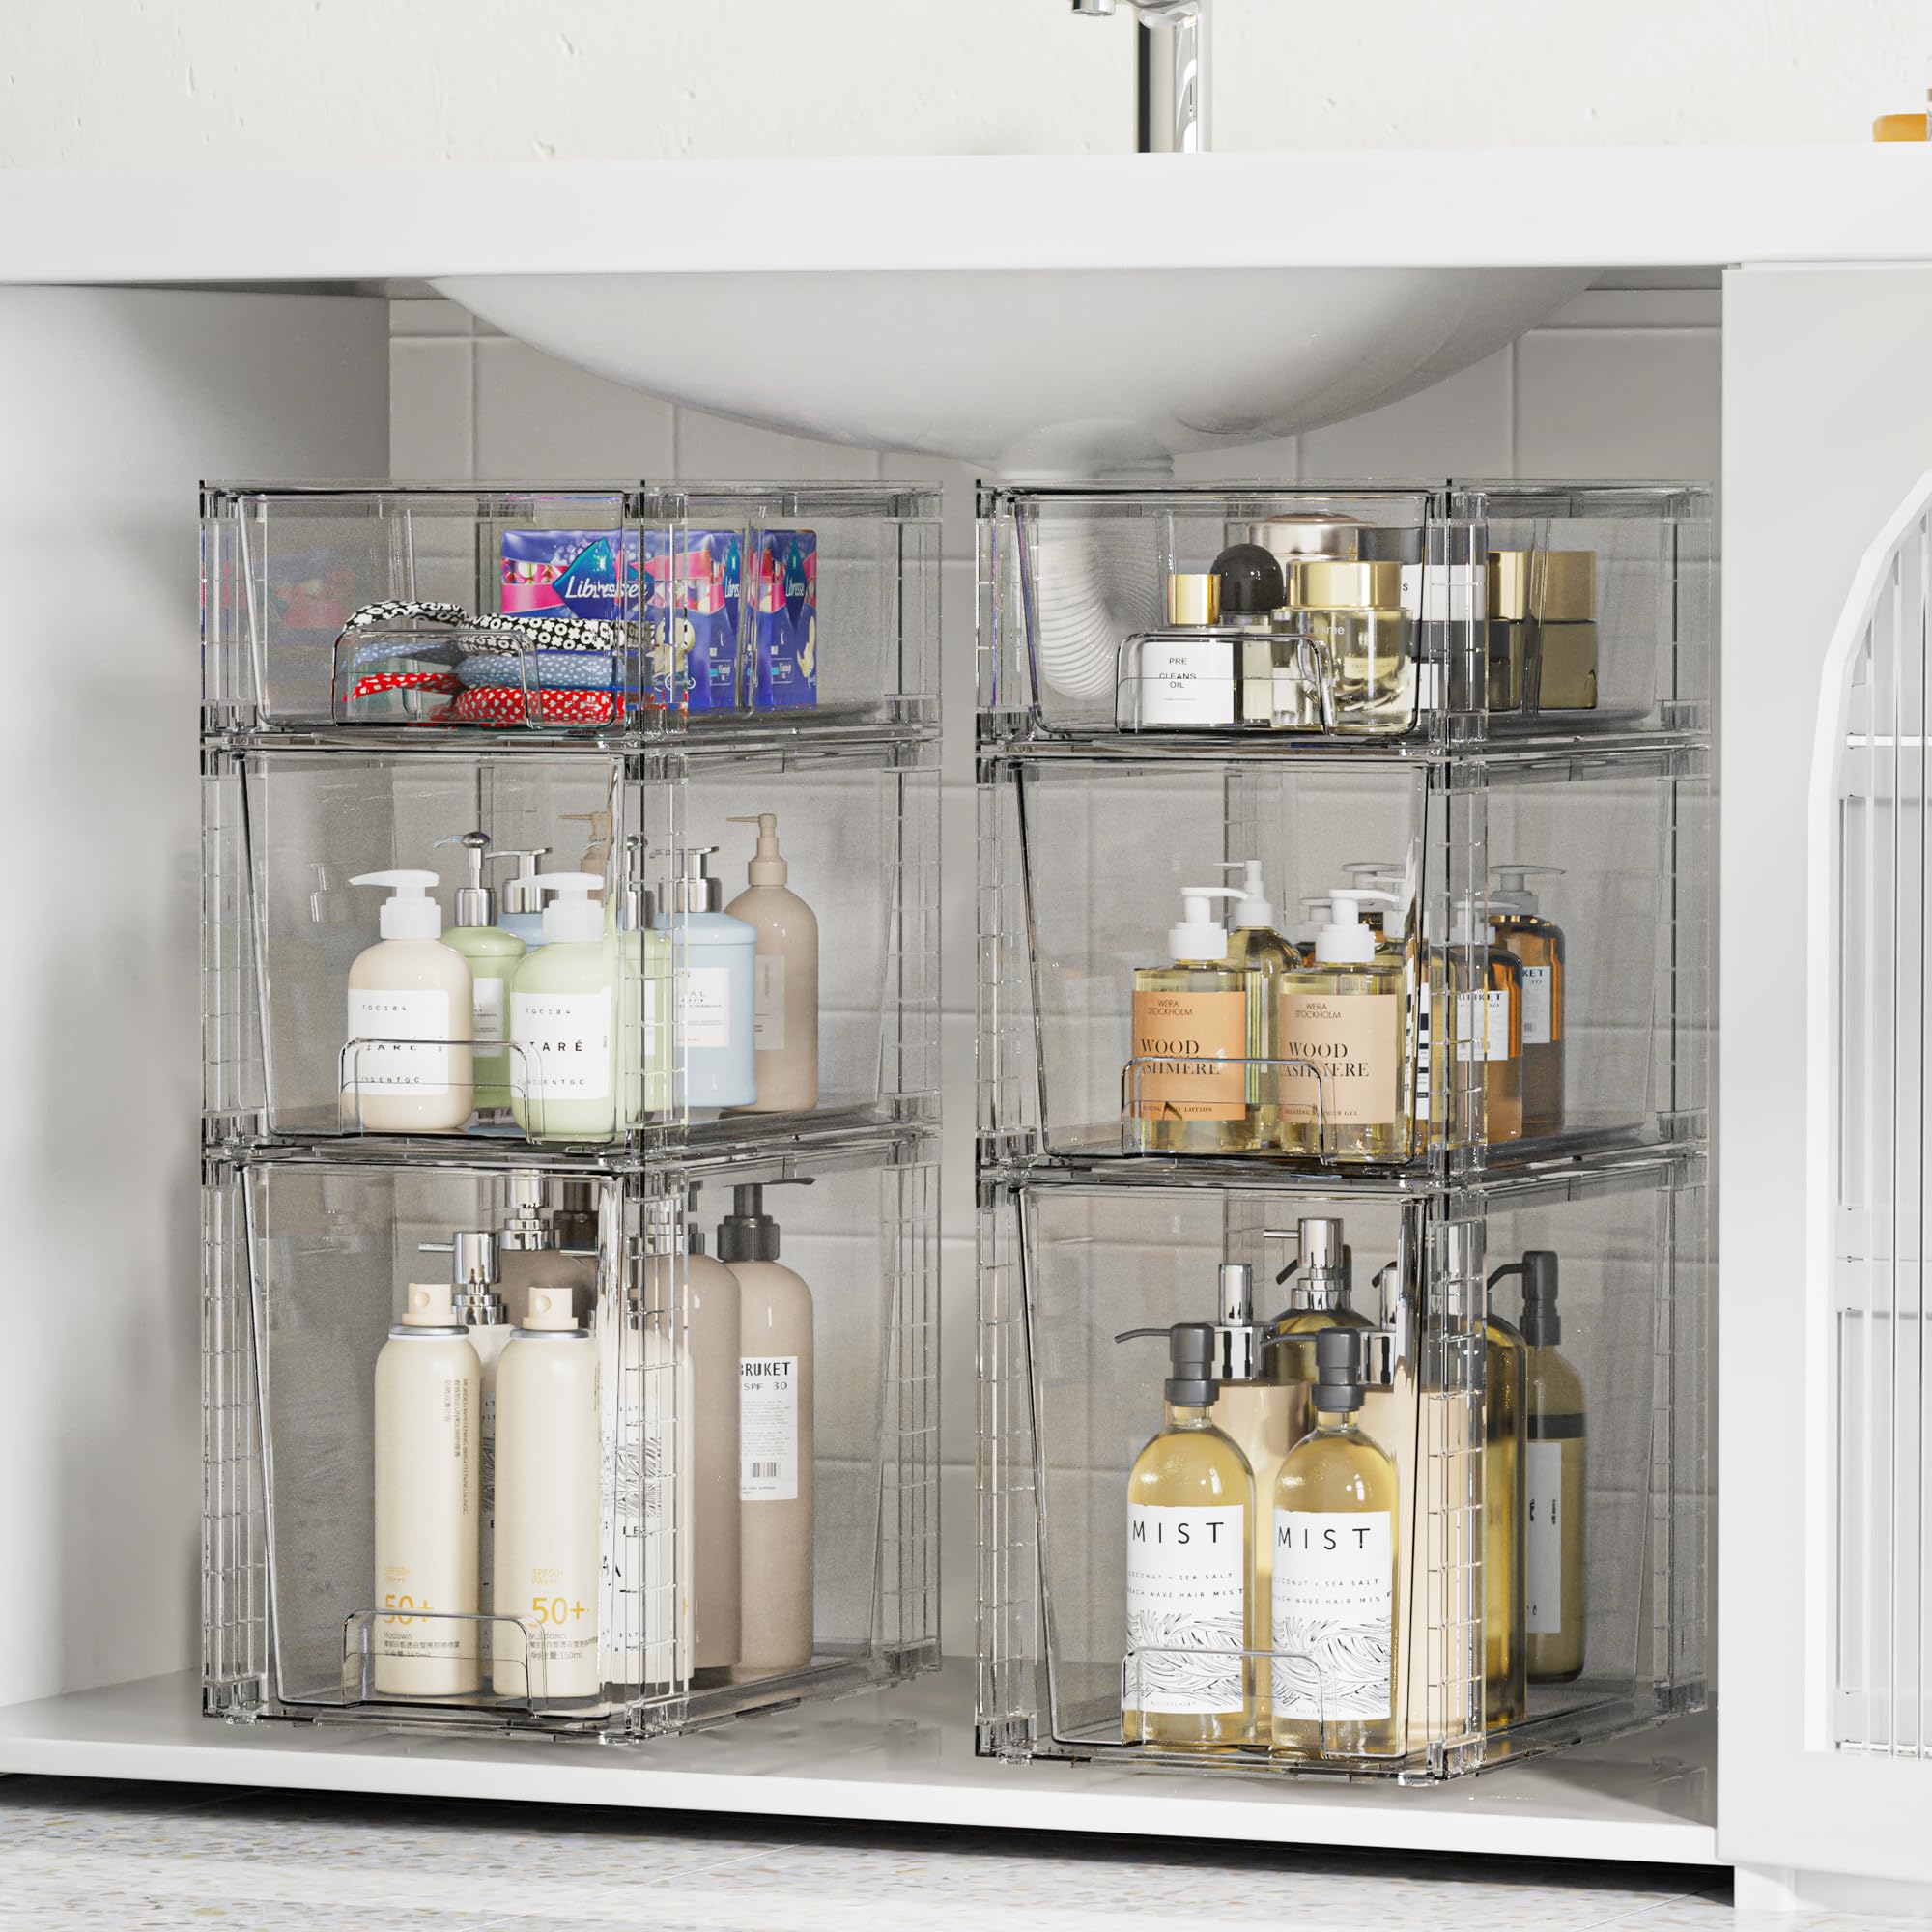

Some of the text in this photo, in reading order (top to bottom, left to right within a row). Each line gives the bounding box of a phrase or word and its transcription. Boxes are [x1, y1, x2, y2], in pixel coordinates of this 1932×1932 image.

[1522, 969, 1544, 978] KET
[1295, 1010, 1342, 1019] STOCKHOLM
[1141, 1038, 1200, 1055] WOOD
[1289, 1042, 1349, 1058] WOOD
[744, 1381, 788, 1391] SPF 30
[1132, 1520, 1225, 1545] MIST
[1278, 1525, 1371, 1550] MIST
[1212, 1587, 1243, 1598] MIST
[384, 1594, 435, 1626] 50+
[530, 1596, 587, 1628] 50+
